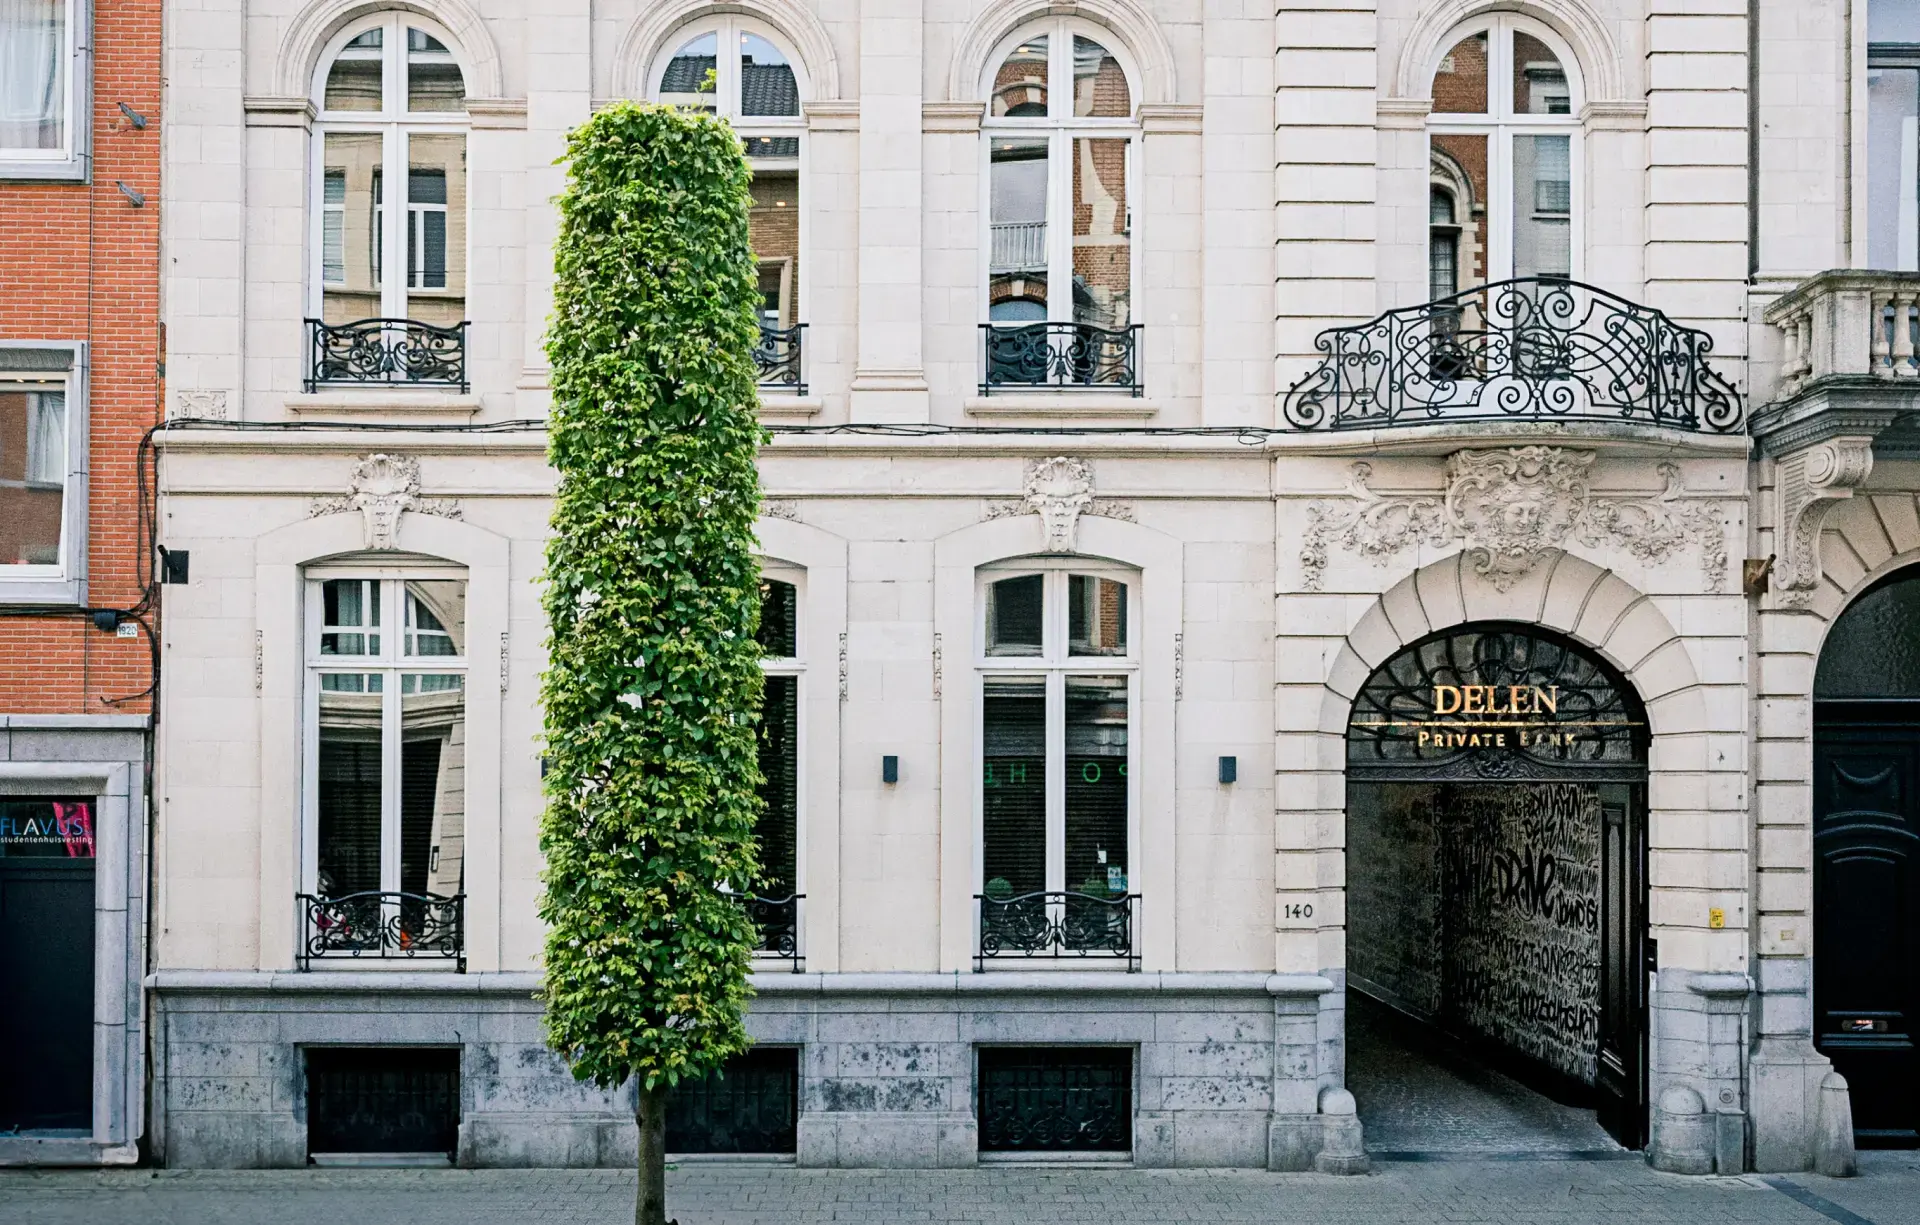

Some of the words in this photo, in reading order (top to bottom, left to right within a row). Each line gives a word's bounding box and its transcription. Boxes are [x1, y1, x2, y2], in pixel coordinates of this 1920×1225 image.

[1433, 684, 1560, 714] DELEN
[1418, 731, 1506, 747] PRIVATE
[0, 818, 83, 836] FLAVUS
[0, 836, 93, 845] studentenhuisvesting
[1284, 903, 1313, 919] 140
